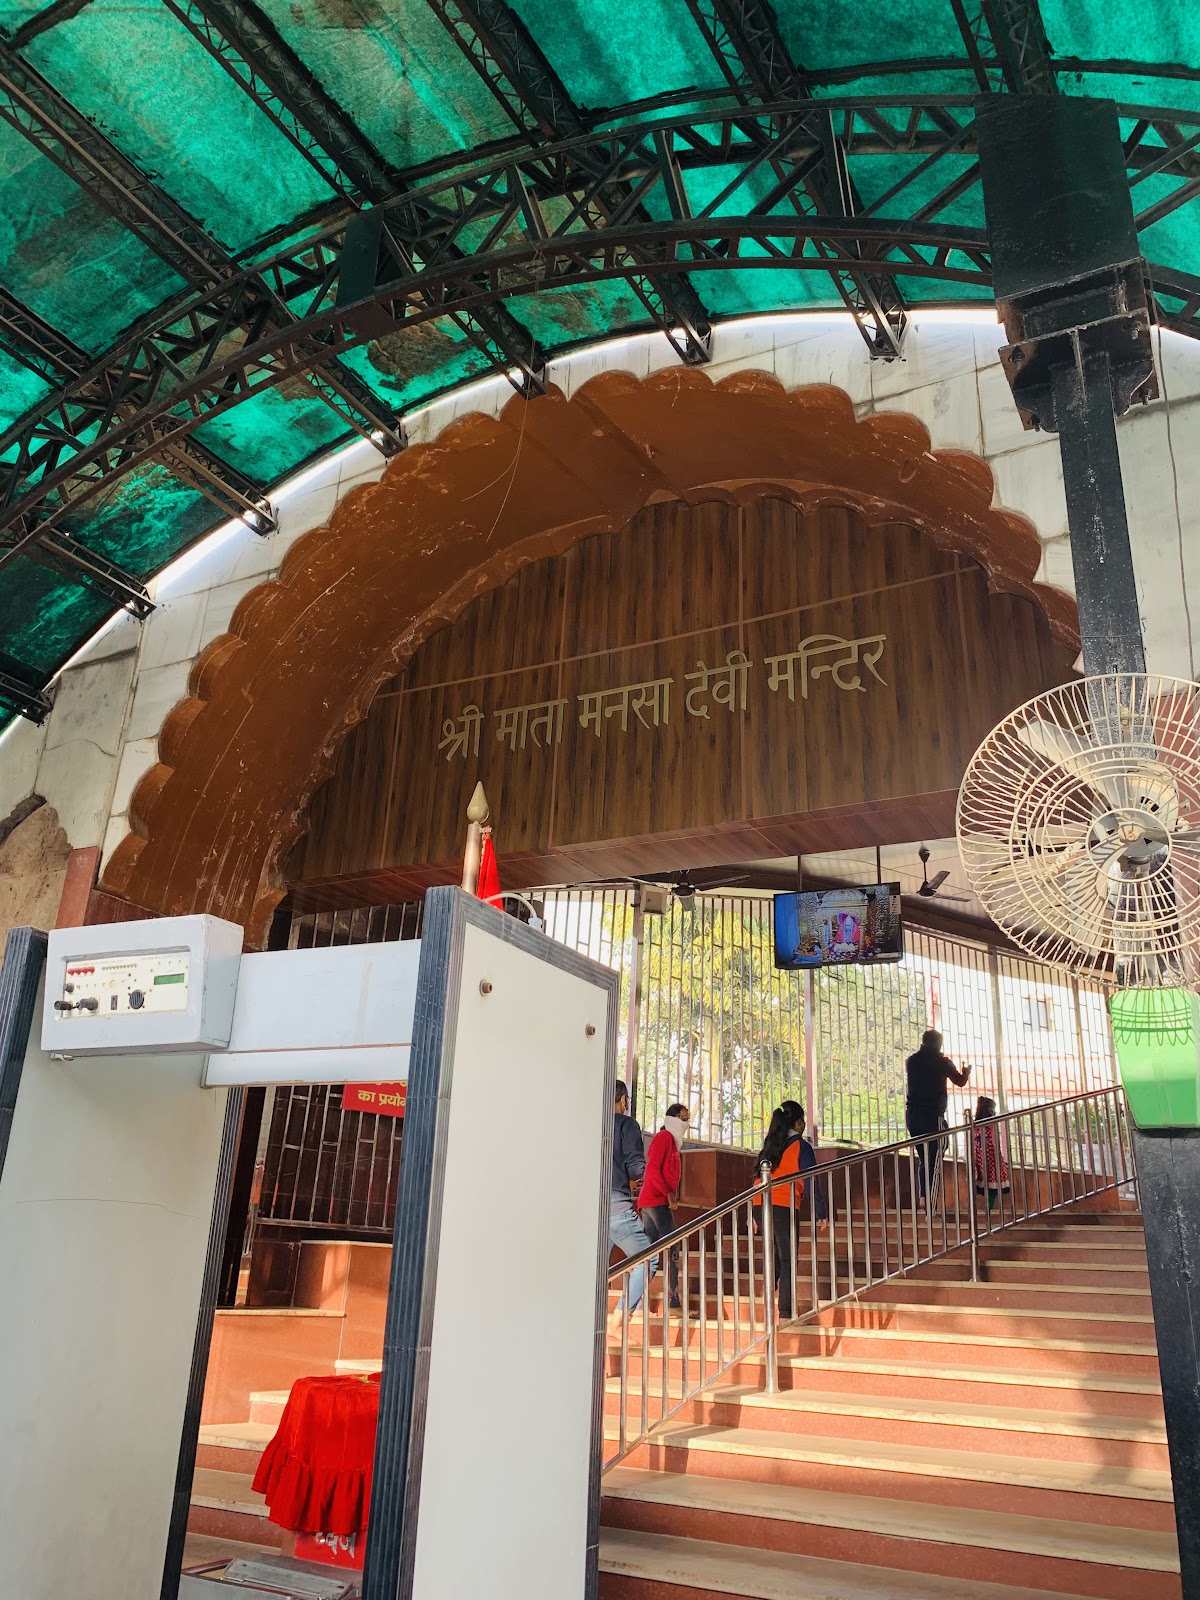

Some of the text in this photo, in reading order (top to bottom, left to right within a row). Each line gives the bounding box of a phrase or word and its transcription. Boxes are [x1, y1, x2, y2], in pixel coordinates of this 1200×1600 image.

[438, 634, 888, 761] श्री माता मनसा देवी मन्दिर
[357, 1090, 376, 1102] का
